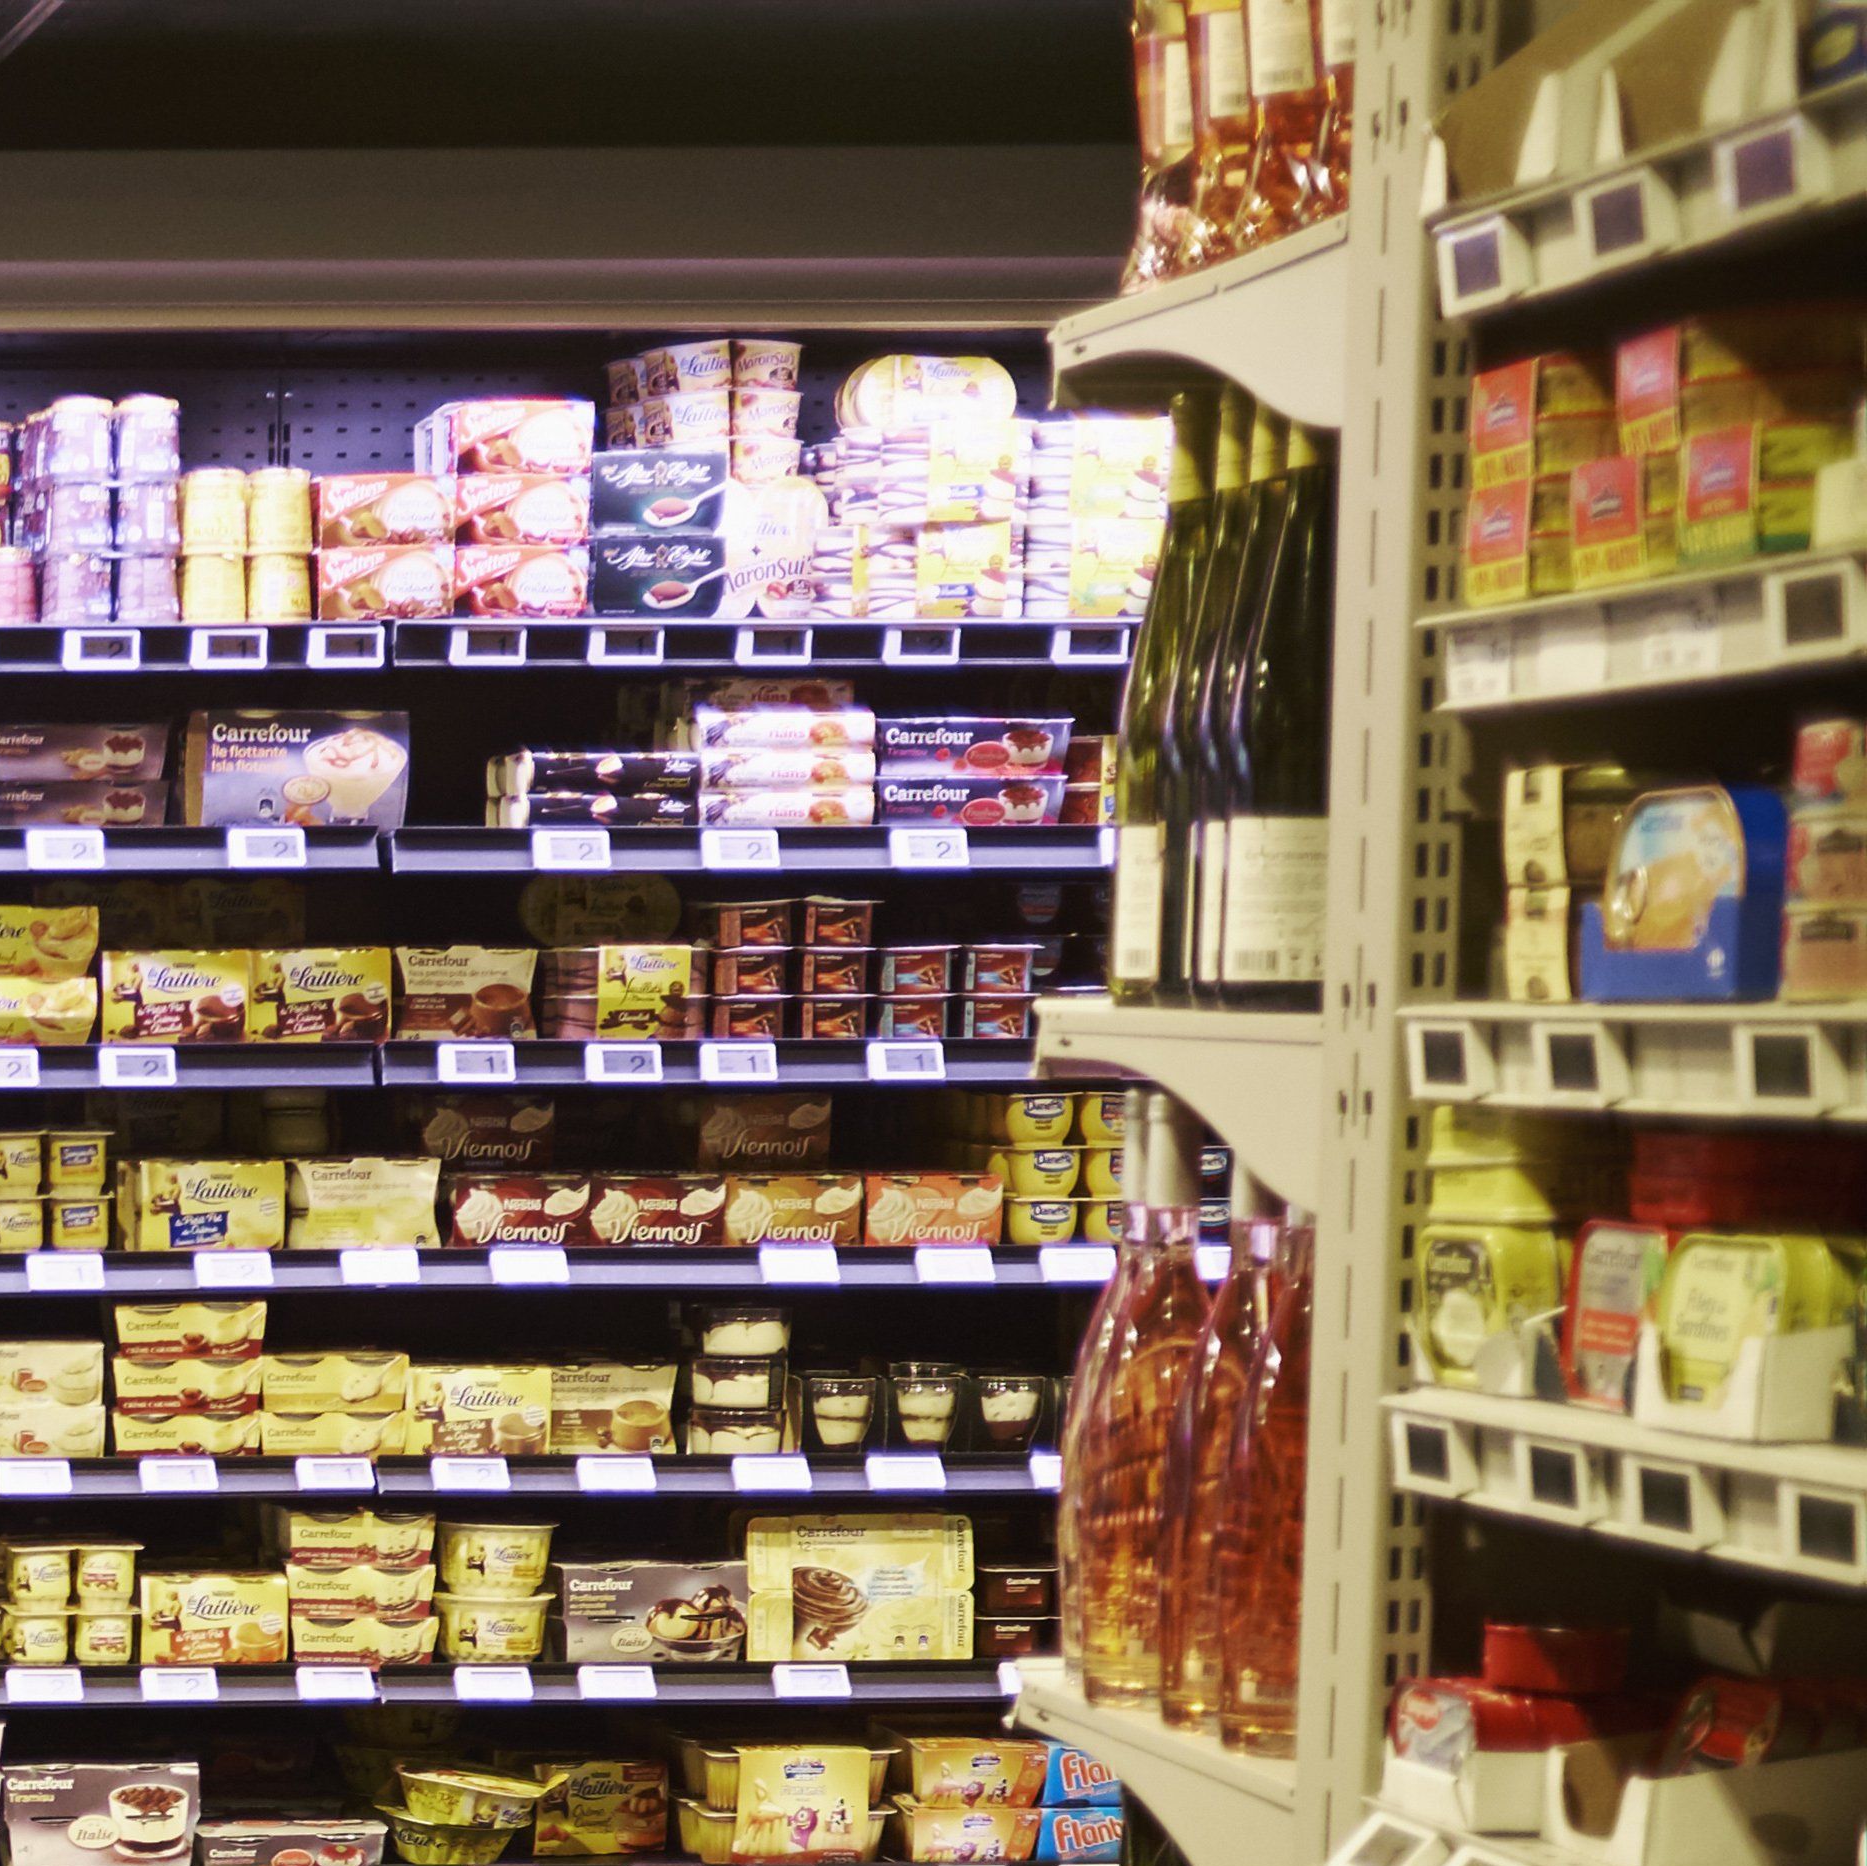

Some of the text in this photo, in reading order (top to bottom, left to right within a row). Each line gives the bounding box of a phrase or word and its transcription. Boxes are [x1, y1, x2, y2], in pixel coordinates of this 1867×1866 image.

[611, 545, 715, 570] After Eight
[212, 724, 311, 743] Carrefour
[885, 728, 973, 746] Carrefour
[229, 744, 288, 758] flottante
[884, 785, 970, 803] Carrefour
[768, 806, 806, 821] rians
[408, 955, 469, 967] Carrefour
[148, 965, 222, 993] Laitière
[291, 965, 365, 993] Laitière
[444, 1132, 543, 1160] Viennois
[720, 1131, 816, 1159] Viennois
[311, 1169, 372, 1181] Carrefour
[187, 1177, 258, 1206] Laitière
[503, 1199, 542, 1211] Nestlé
[638, 1199, 678, 1211] Nestlé
[773, 1199, 812, 1210] Nestlé
[916, 1199, 955, 1210] Nestlé
[475, 1213, 577, 1245] Viennois
[611, 1213, 714, 1245] Viennois
[746, 1212, 843, 1242] Viennois
[889, 1213, 986, 1242] Viennois
[125, 1320, 180, 1332] Carrefour
[124, 1375, 178, 1386] Carrefour
[267, 1372, 317, 1383] Carrefour
[550, 1370, 612, 1386] Carrefour
[450, 1384, 524, 1410] Laitière
[123, 1428, 177, 1440] Carrefour
[267, 1427, 316, 1438] Carrefour
[299, 1528, 353, 1540] Carrefour
[796, 1524, 866, 1538] Carrefour
[956, 1518, 966, 1572] Carrefour
[297, 1580, 351, 1591] Carrefour
[569, 1578, 633, 1592] Carrefour
[1005, 1576, 1041, 1586] Carrefour
[187, 1596, 262, 1621] Laitière
[958, 1593, 968, 1648] Carrefour
[995, 1624, 1031, 1633] Carrefour
[301, 1632, 354, 1644] Carrefour
[7, 1776, 74, 1791] Carrefour
[75, 1828, 114, 1842] Italie
[1053, 1815, 1124, 1852] Flanb
